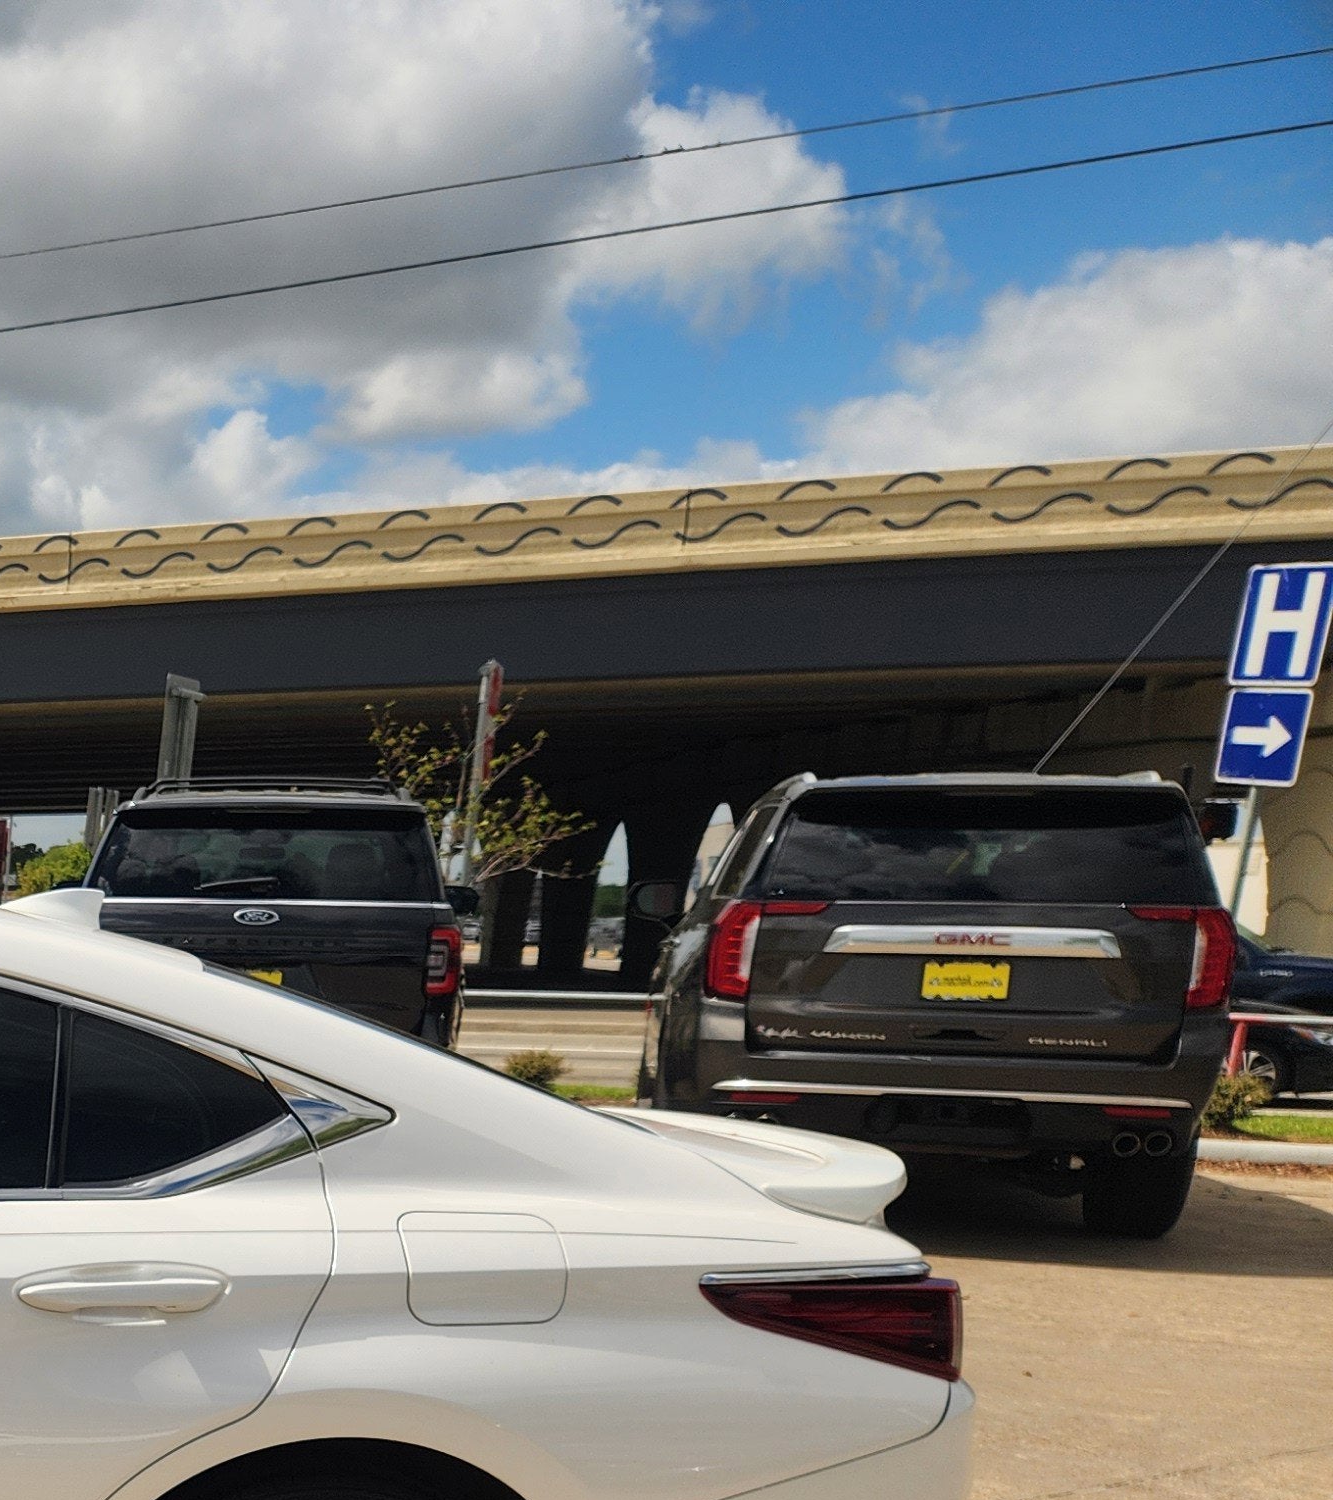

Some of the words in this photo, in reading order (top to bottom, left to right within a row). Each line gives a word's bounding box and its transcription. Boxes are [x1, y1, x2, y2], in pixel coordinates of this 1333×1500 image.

[1244, 571, 1327, 677] H
[935, 932, 1011, 946] GMC
[1028, 1037, 1107, 1047] DENALI
